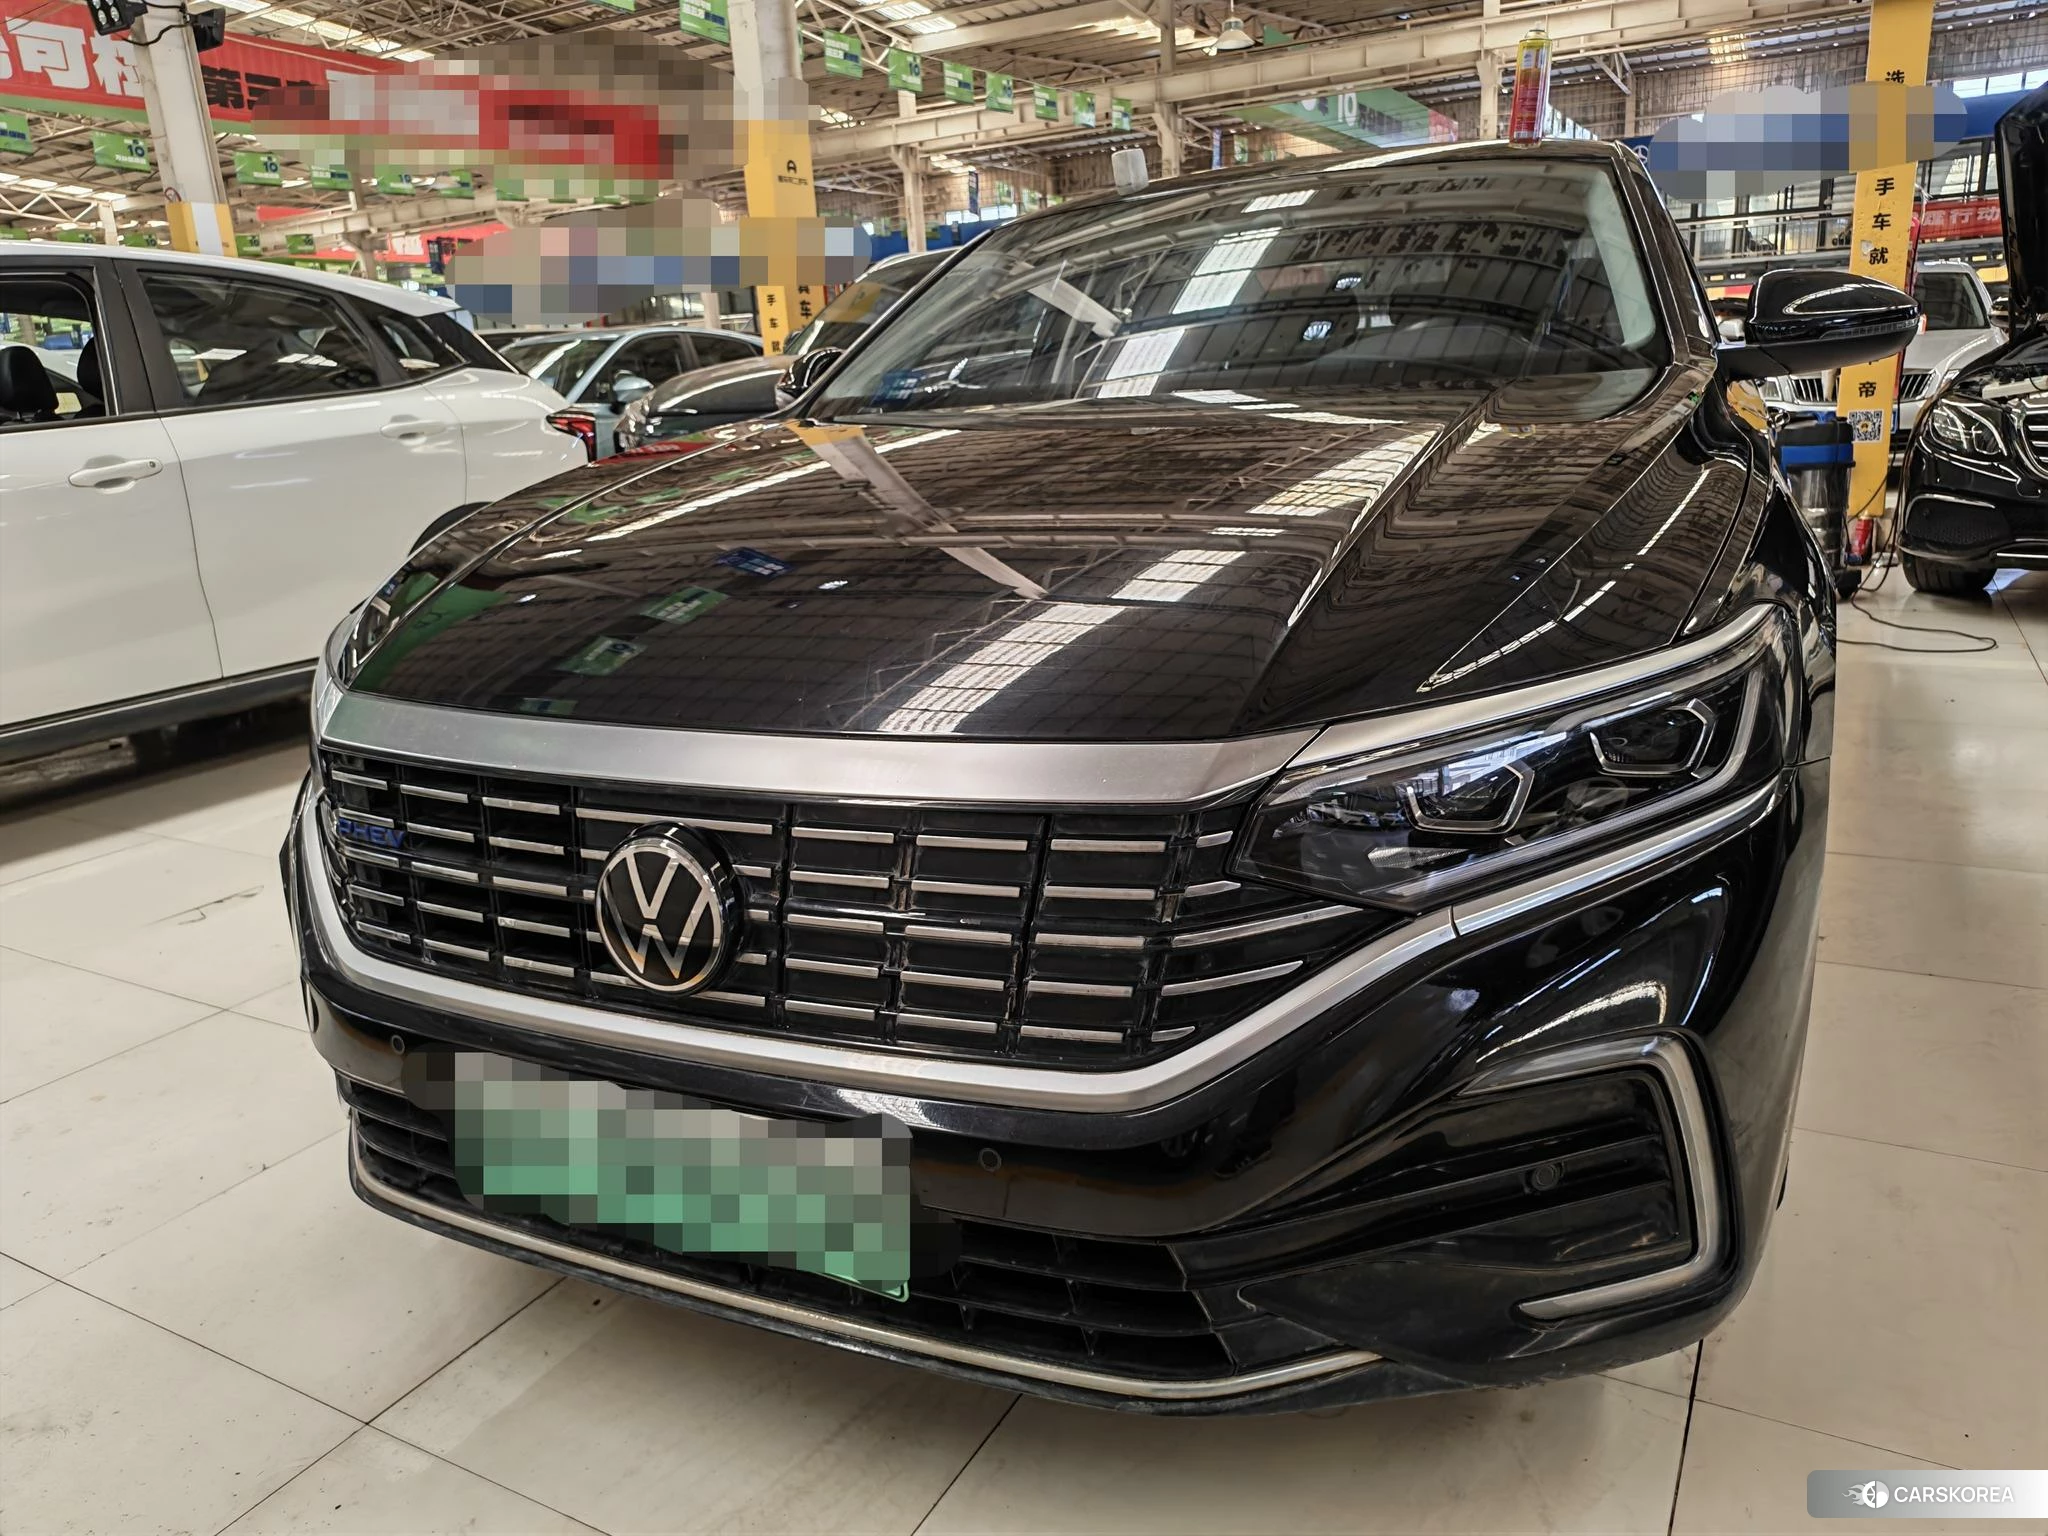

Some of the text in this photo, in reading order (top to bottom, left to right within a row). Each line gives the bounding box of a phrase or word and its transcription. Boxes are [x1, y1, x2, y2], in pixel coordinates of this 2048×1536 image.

[1337, 92, 1358, 127] 10
[127, 144, 145, 158] 10
[263, 161, 279, 174] 10
[1869, 177, 1895, 265] 手车就
[1858, 381, 1877, 398] 帝
[337, 817, 404, 849] PHEV
